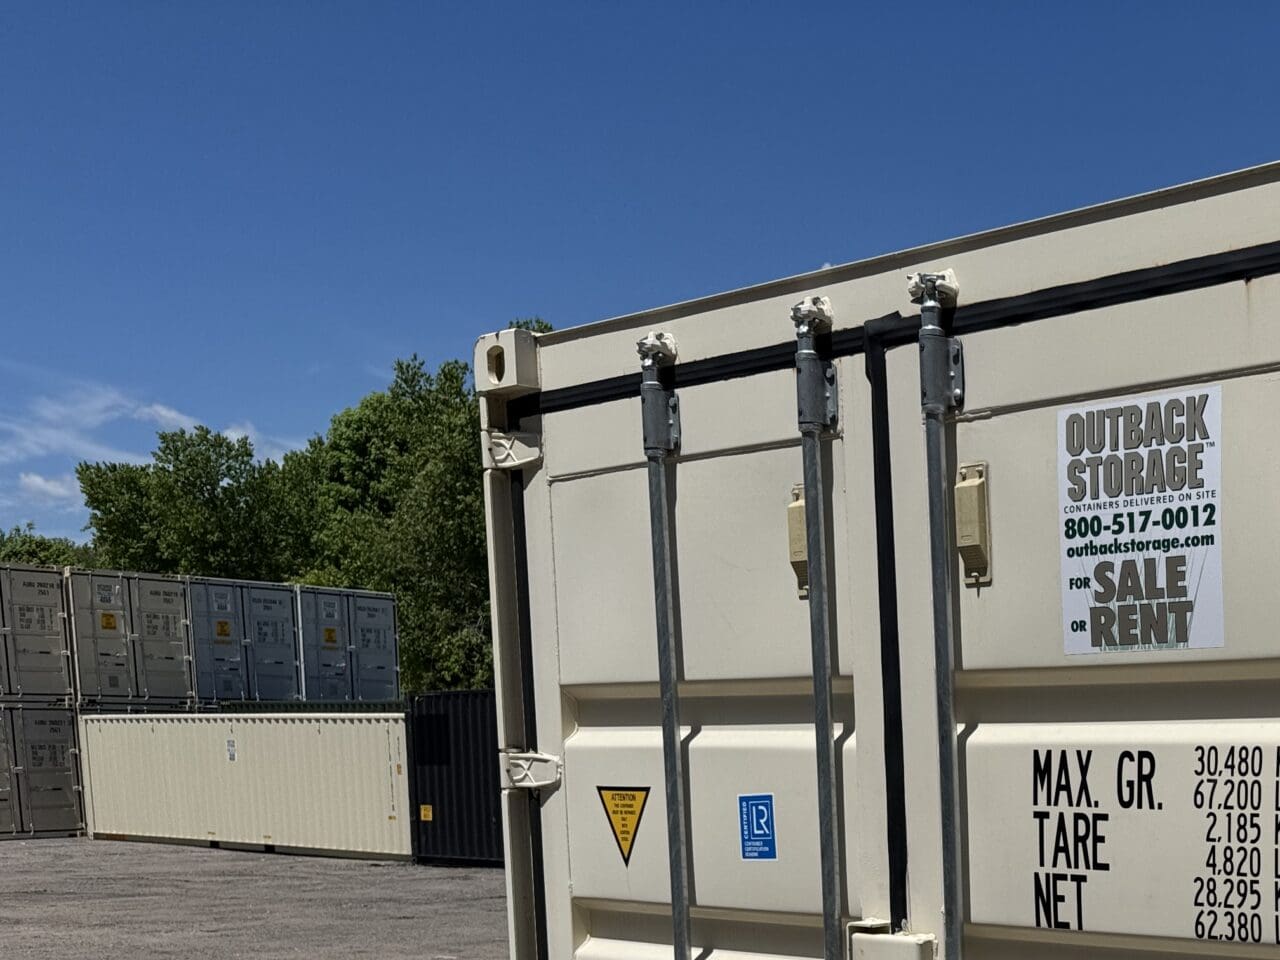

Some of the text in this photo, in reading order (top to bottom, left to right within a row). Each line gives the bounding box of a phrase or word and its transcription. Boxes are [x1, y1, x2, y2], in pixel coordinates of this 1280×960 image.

[1065, 394, 1209, 457] OUTBACK
[1067, 443, 1205, 502] STORAGE
[1063, 490, 1217, 514] CONTAINERS DELIVERED ON SITE
[1064, 503, 1216, 539] 800-517-0012
[1066, 534, 1215, 558] outbackstorage.com
[1069, 555, 1188, 604] FOR SALE
[1070, 600, 1193, 647] OR RENT
[1194, 745, 1263, 778] 30,480
[1033, 749, 1163, 810] MAX. GR.
[1193, 779, 1262, 811] 67,200
[1033, 810, 1110, 871] TARE
[1205, 812, 1261, 844] 2,185
[1205, 845, 1261, 877] 4,820
[1033, 871, 1087, 931] NET
[1193, 877, 1262, 910] 28,295
[1194, 910, 1262, 943] 62,380
